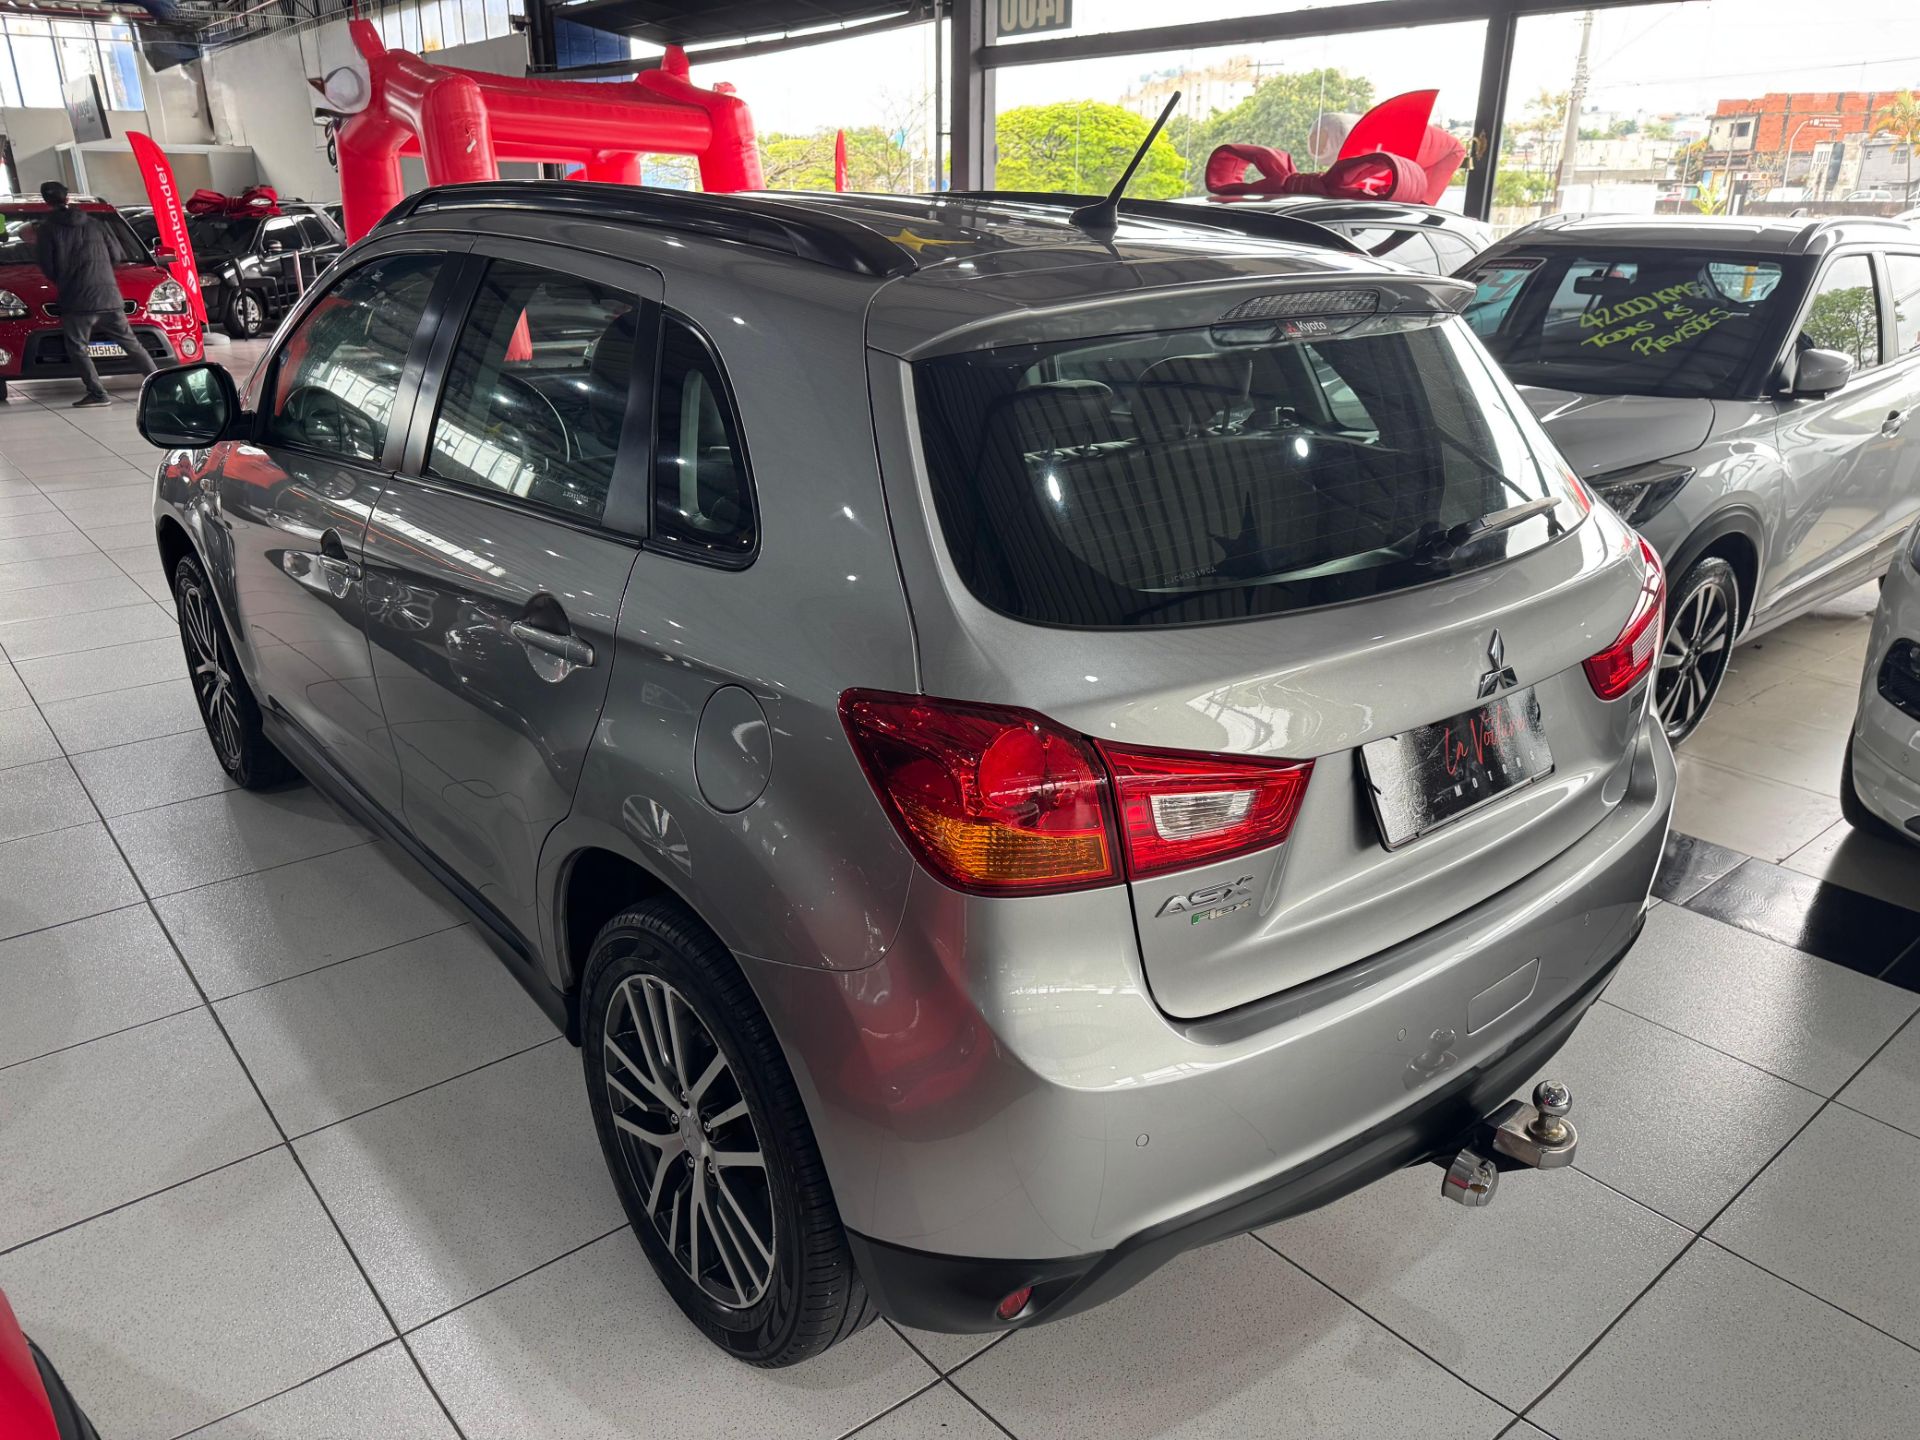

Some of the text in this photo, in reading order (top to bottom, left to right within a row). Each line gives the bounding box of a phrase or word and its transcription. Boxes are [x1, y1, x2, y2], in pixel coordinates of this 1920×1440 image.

[155, 164, 191, 267] Santander
[1295, 320, 1327, 333] Kyoto
[1579, 296, 1659, 329] 42.000
[1154, 874, 1254, 918] ASX
